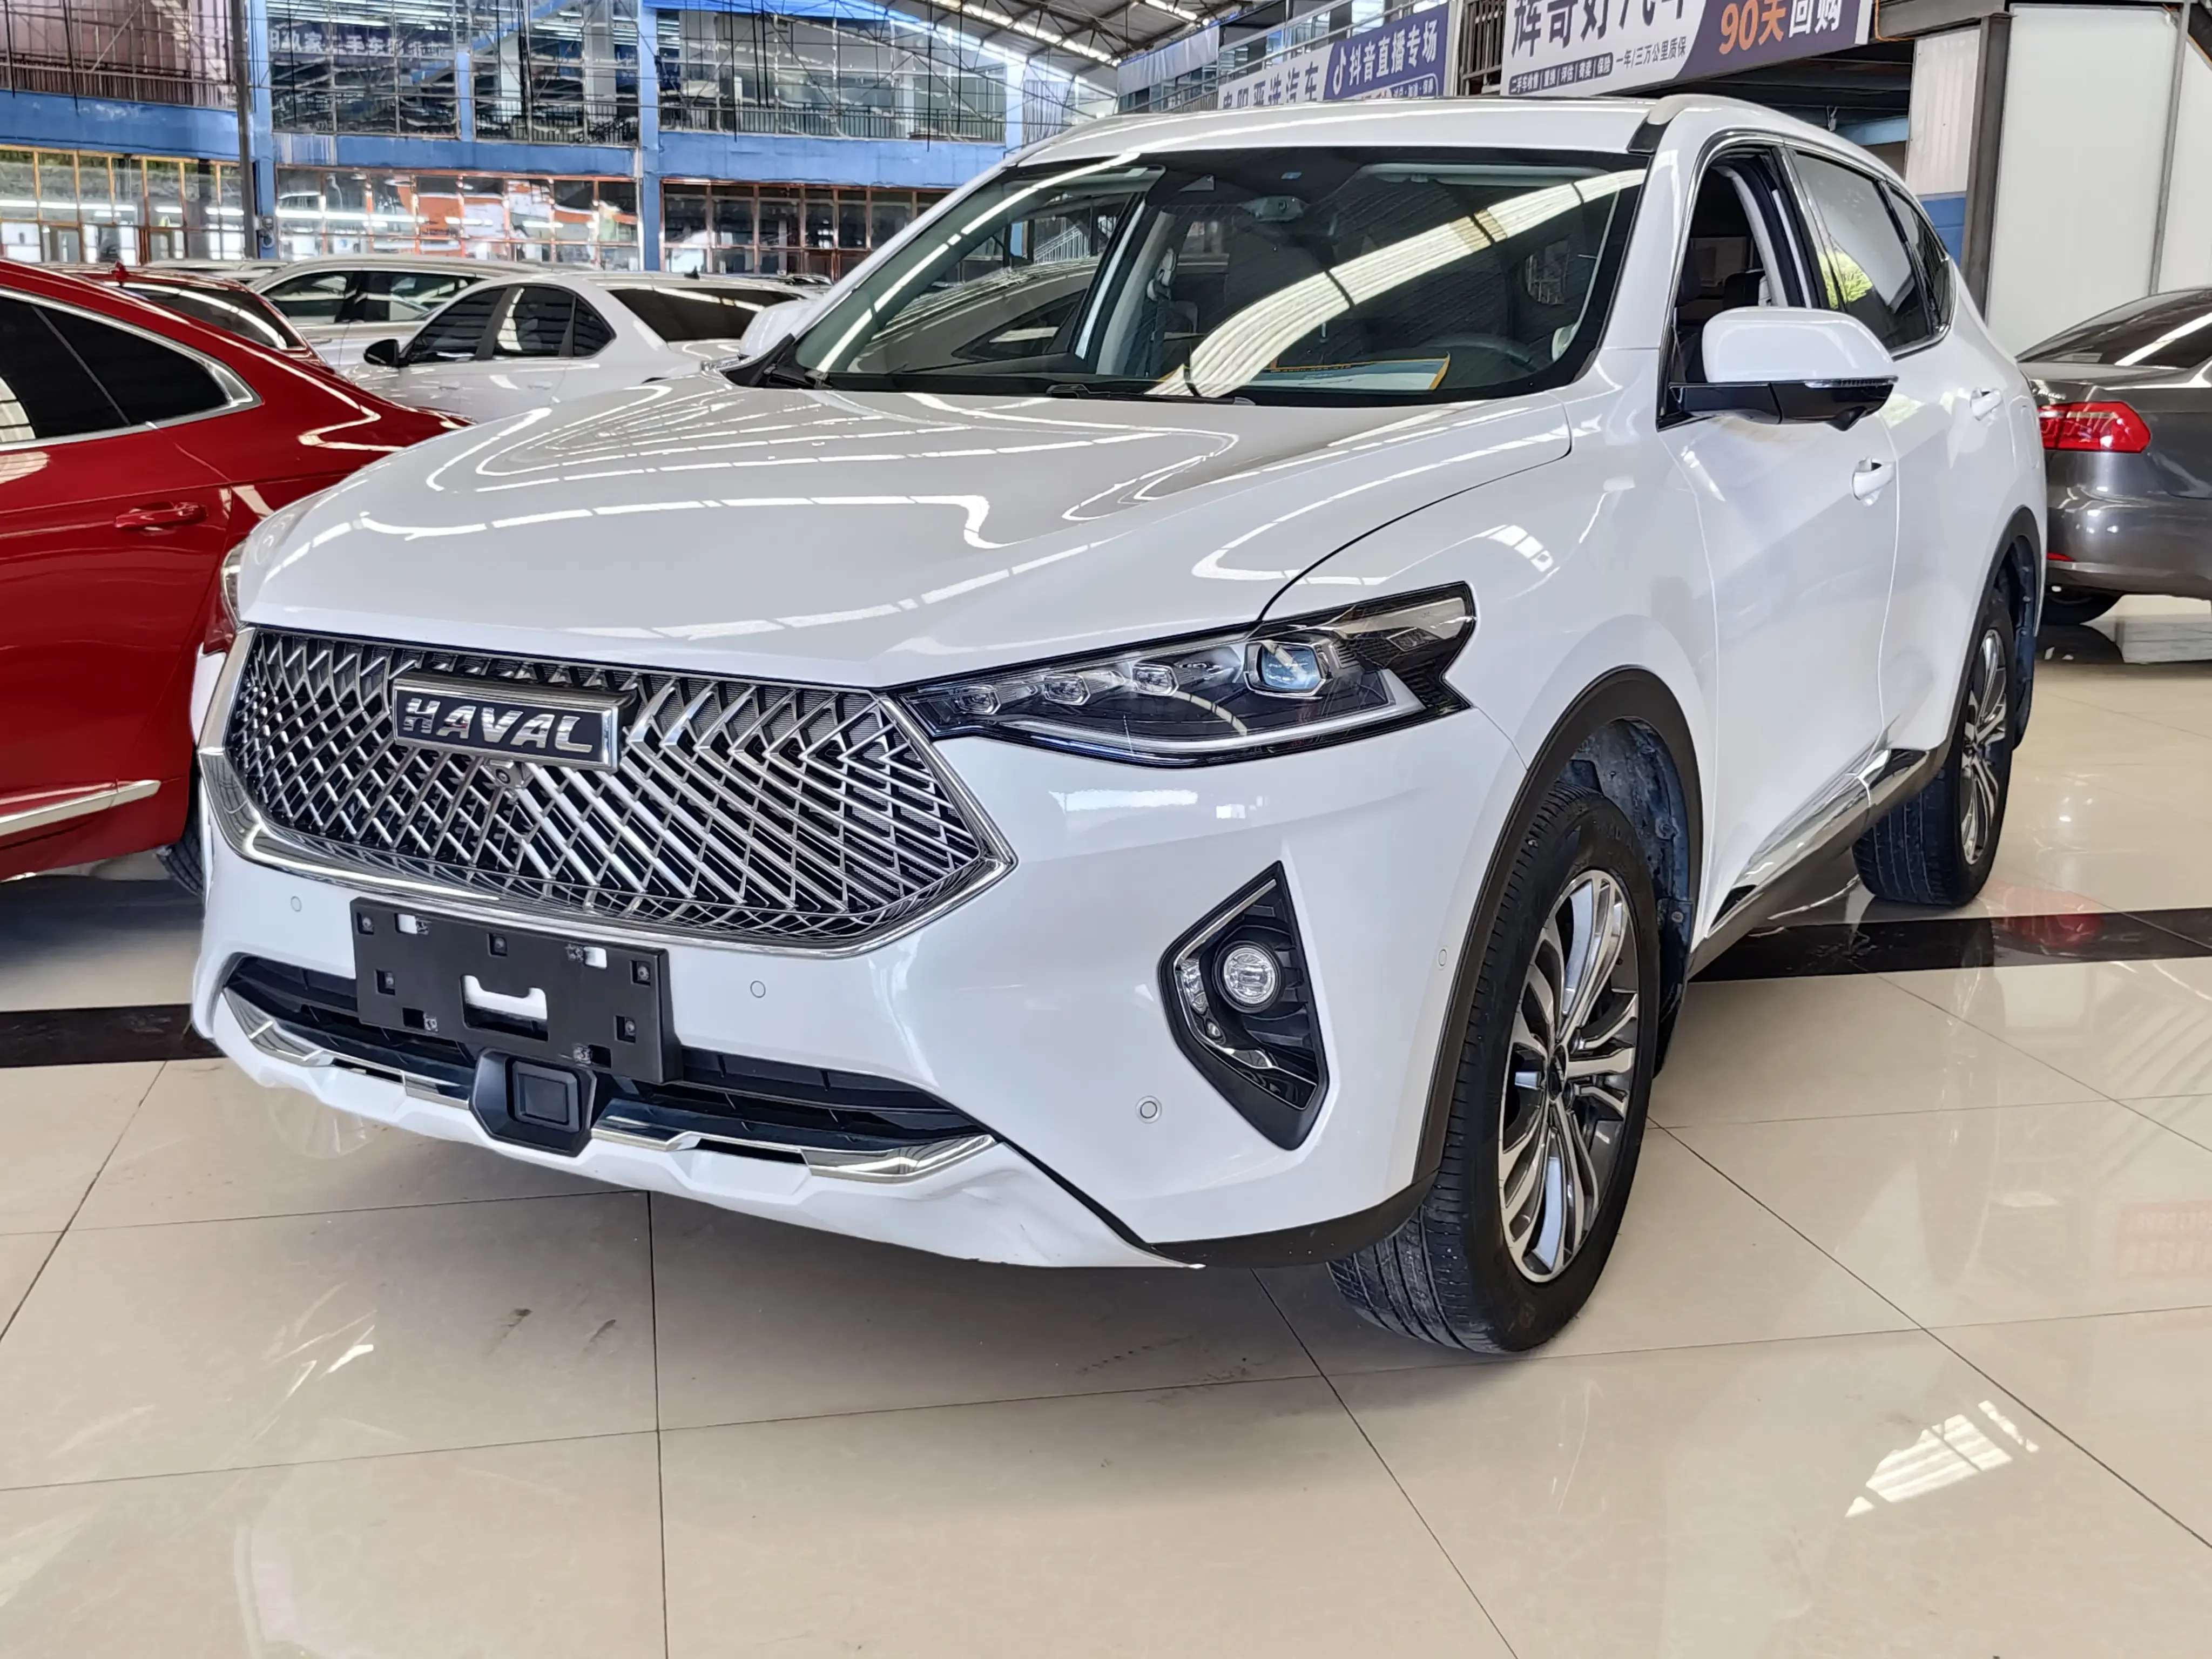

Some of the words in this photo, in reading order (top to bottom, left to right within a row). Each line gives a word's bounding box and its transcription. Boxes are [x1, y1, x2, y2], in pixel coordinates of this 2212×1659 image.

[1348, 19, 1438, 86] 抖音直播专场
[1616, 36, 1687, 69] 一年/三万公里质保
[403, 697, 593, 753] HAVAL
